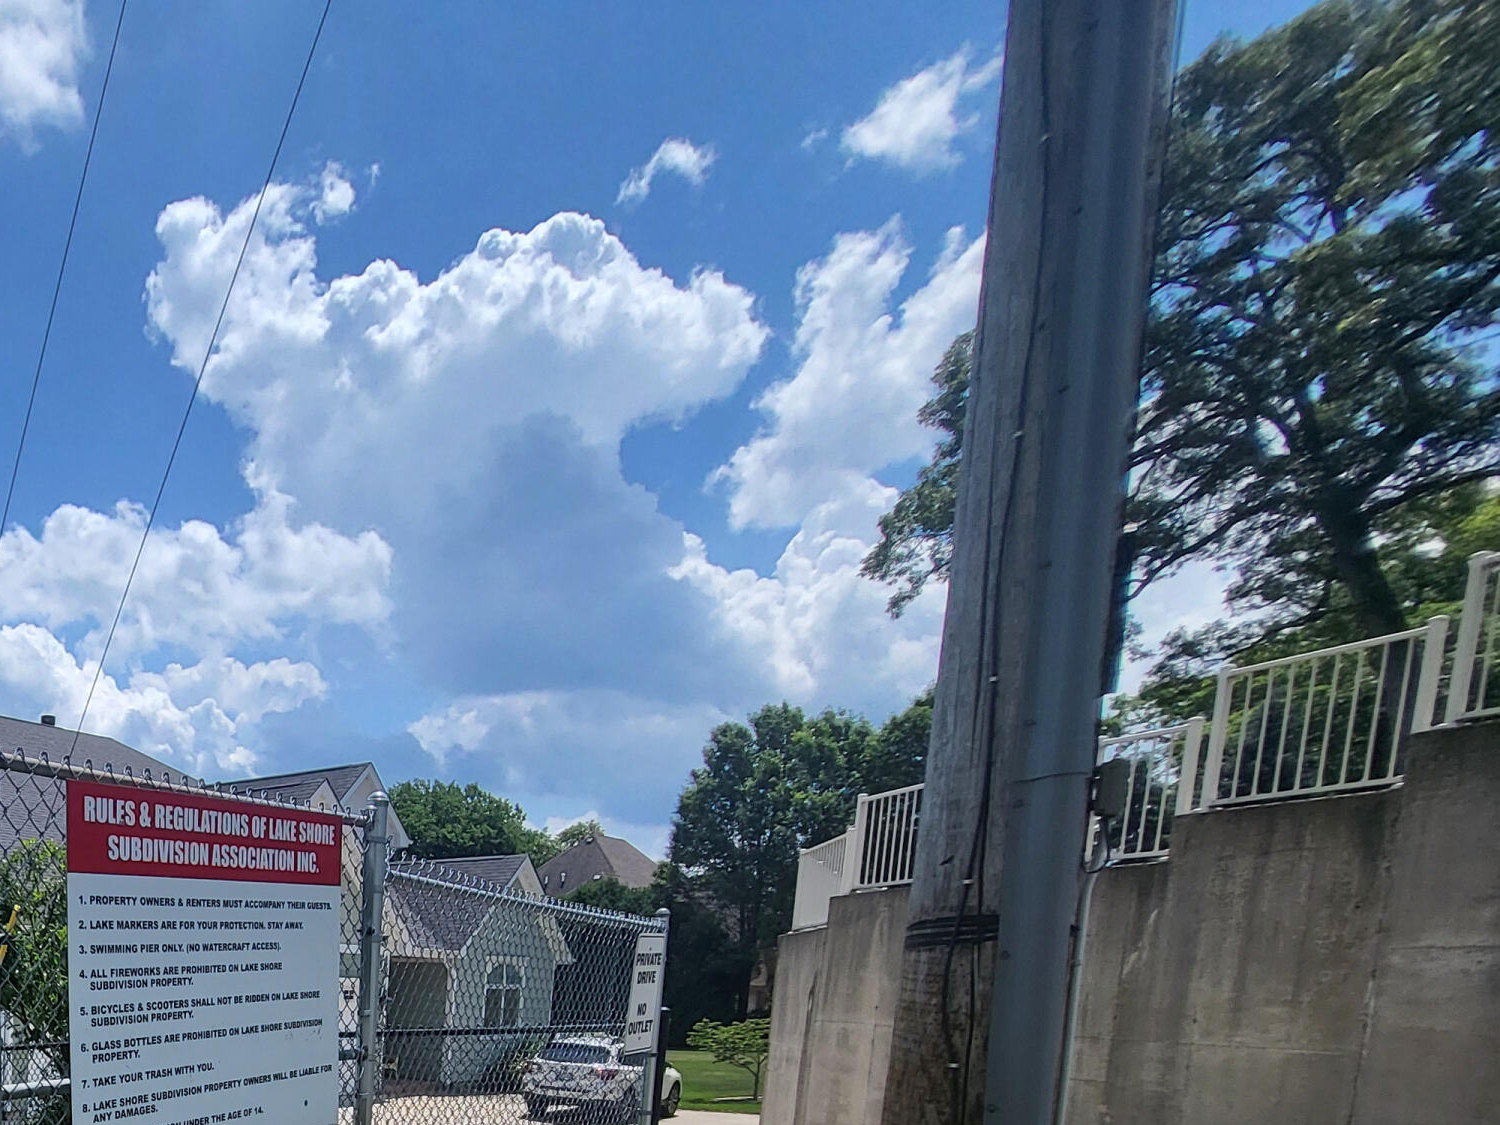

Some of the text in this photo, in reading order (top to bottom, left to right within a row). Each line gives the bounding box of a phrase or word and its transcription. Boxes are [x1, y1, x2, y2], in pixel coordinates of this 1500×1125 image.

[84, 796, 335, 845] RULES & REGULATIONS OF LAKE SHORE
[108, 835, 319, 873] SUBDIVISION ASSOCIATION INC.
[79, 896, 86, 904] 1.
[90, 896, 137, 906] PROPERTY
[140, 897, 175, 906] OWNERS
[186, 899, 220, 908] RENTERS
[223, 900, 242, 908] MUST
[245, 901, 285, 909] ACCOMPANY
[308, 902, 332, 910] GUESTS.
[79, 920, 86, 929] 2.
[90, 920, 114, 929] LAKE
[117, 921, 158, 929] MARKERS
[161, 921, 177, 929] ARE
[180, 921, 194, 929] FOR
[79, 943, 281, 954] 3. SWIMMING PIER ONLY. (NO WATERCRAFT ACCESS).
[636, 953, 662, 965] PRIVATE
[79, 970, 87, 978] 4.
[91, 969, 107, 978] ALL
[111, 967, 160, 977] FIREWORKS
[163, 967, 179, 975] ARE
[181, 964, 226, 974] PROHIBITED
[229, 964, 238, 972] ON
[241, 963, 258, 971] LAKE
[637, 971, 656, 984] DRIVE
[90, 978, 194, 990] SUBDIVISION PROPERTY.
[80, 1007, 88, 1015] 5.
[92, 1004, 134, 1015] BICYCLES
[138, 1003, 143, 1011] &
[147, 1000, 189, 1010] SCOOTERS
[191, 998, 214, 1007] SHALL
[217, 997, 232, 1005] NOT
[234, 996, 242, 1004] BE
[245, 994, 269, 1003] RIDDEN
[283, 992, 298, 1000] LAKE
[300, 991, 320, 999] SHORE
[637, 1003, 646, 1016] NO
[91, 1011, 194, 1027] SUBDIVISION PROPERTY.
[629, 1020, 653, 1035] OUTLET
[81, 1019, 322, 1052] 6. GLASS BOTTLES ARE PROHIBITED ON LAKE SHORE SUBDIVISION
[93, 1050, 140, 1063] PROPERTY.
[82, 1063, 214, 1088] 7. TAKE YOUR TRASH WITH YOU.
[83, 1065, 332, 1112] 8. LAKE SHORE SUBDIVISION PROPERTY OWNERS WILL BE LIABLE FOR
[93, 1105, 158, 1123] ANY DAMAGES.
[212, 1114, 226, 1123] THE
[228, 1111, 241, 1120] AGE
[244, 1108, 252, 1116] OF
[255, 1107, 263, 1115] 14.
